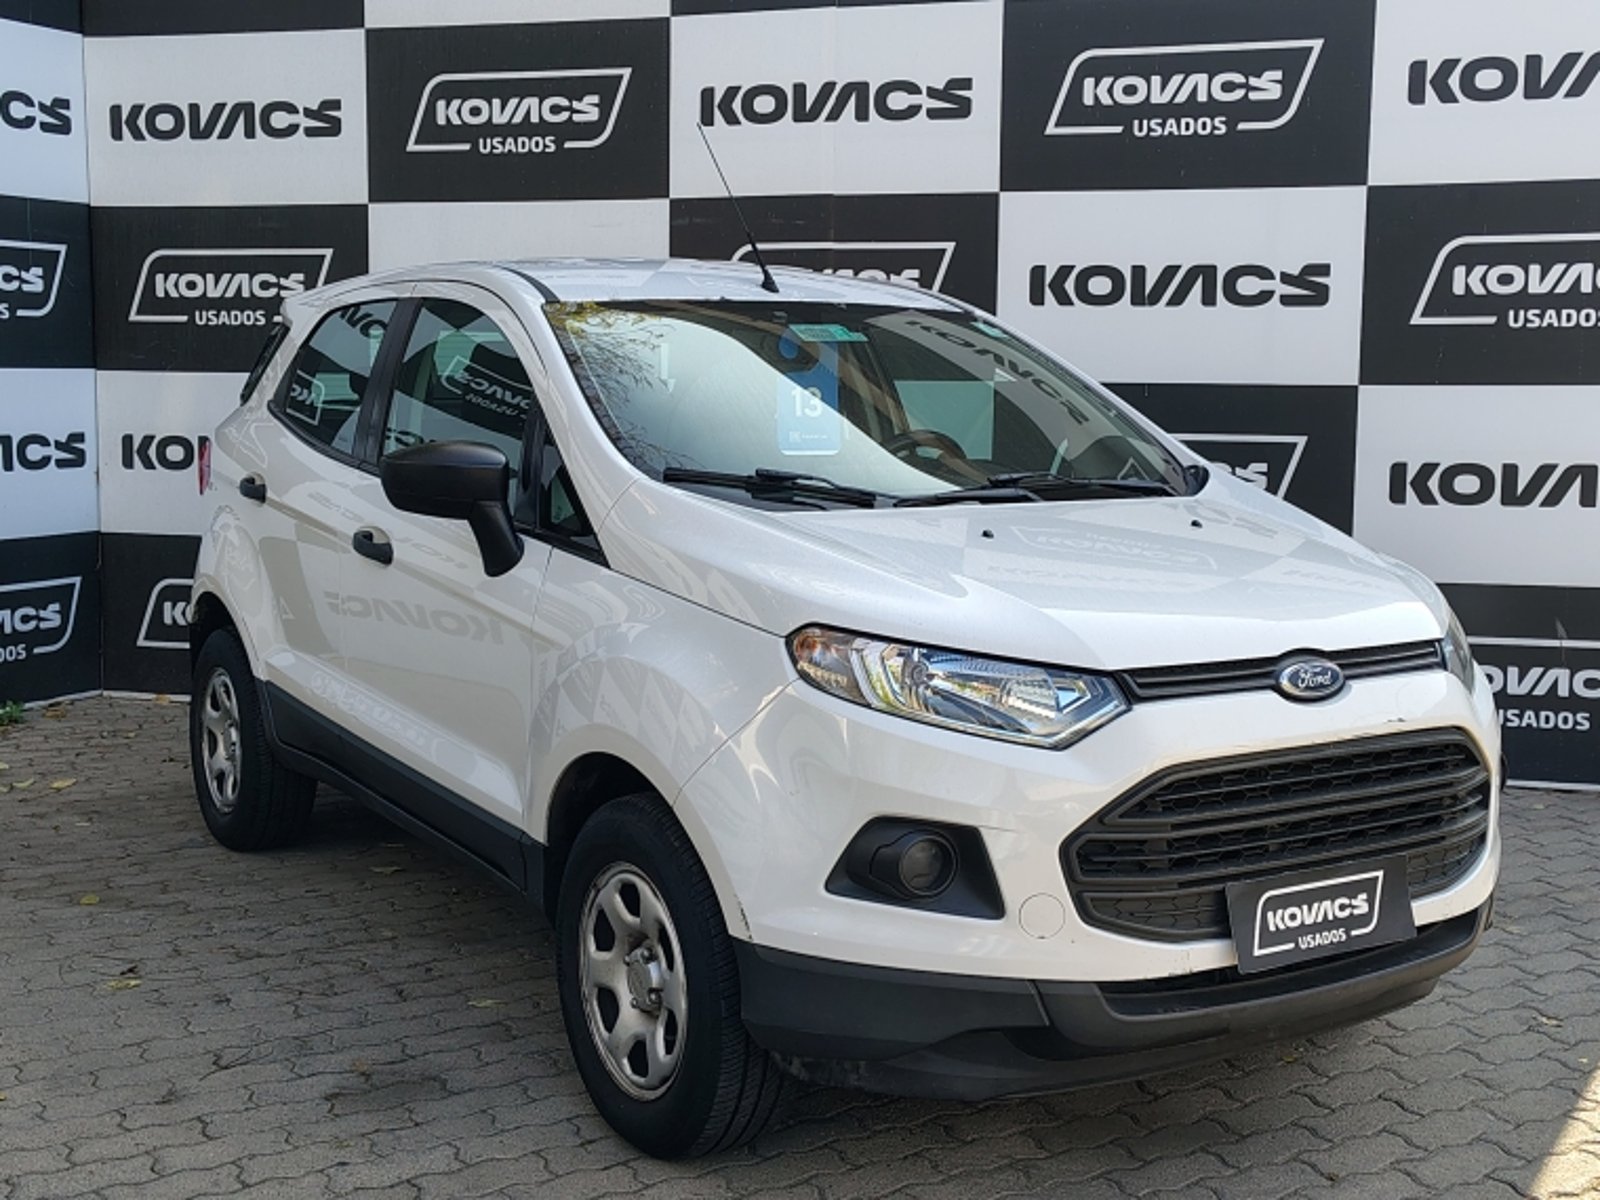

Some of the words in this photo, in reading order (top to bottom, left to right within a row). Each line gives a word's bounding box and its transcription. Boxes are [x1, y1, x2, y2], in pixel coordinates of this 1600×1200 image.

[700, 77, 974, 127] KOVACS
[1082, 69, 1283, 106] KOVACS
[109, 98, 342, 142] KOVACS
[435, 94, 601, 126] KOVACS
[1132, 116, 1227, 137] USADOS
[478, 136, 557, 154] USADOS
[155, 273, 304, 299] KOVACS
[1029, 263, 1332, 308] KOVACS
[1452, 262, 1600, 296] KOVA
[194, 310, 267, 326] USADOS
[1507, 308, 1600, 329] USADO
[791, 387, 824, 418] 13
[121, 434, 211, 470] KO
[1389, 462, 1598, 508] KOVA
[1298, 663, 1332, 688] Ford
[1266, 892, 1370, 932] KOVACS
[1298, 927, 1347, 950] USADOS
